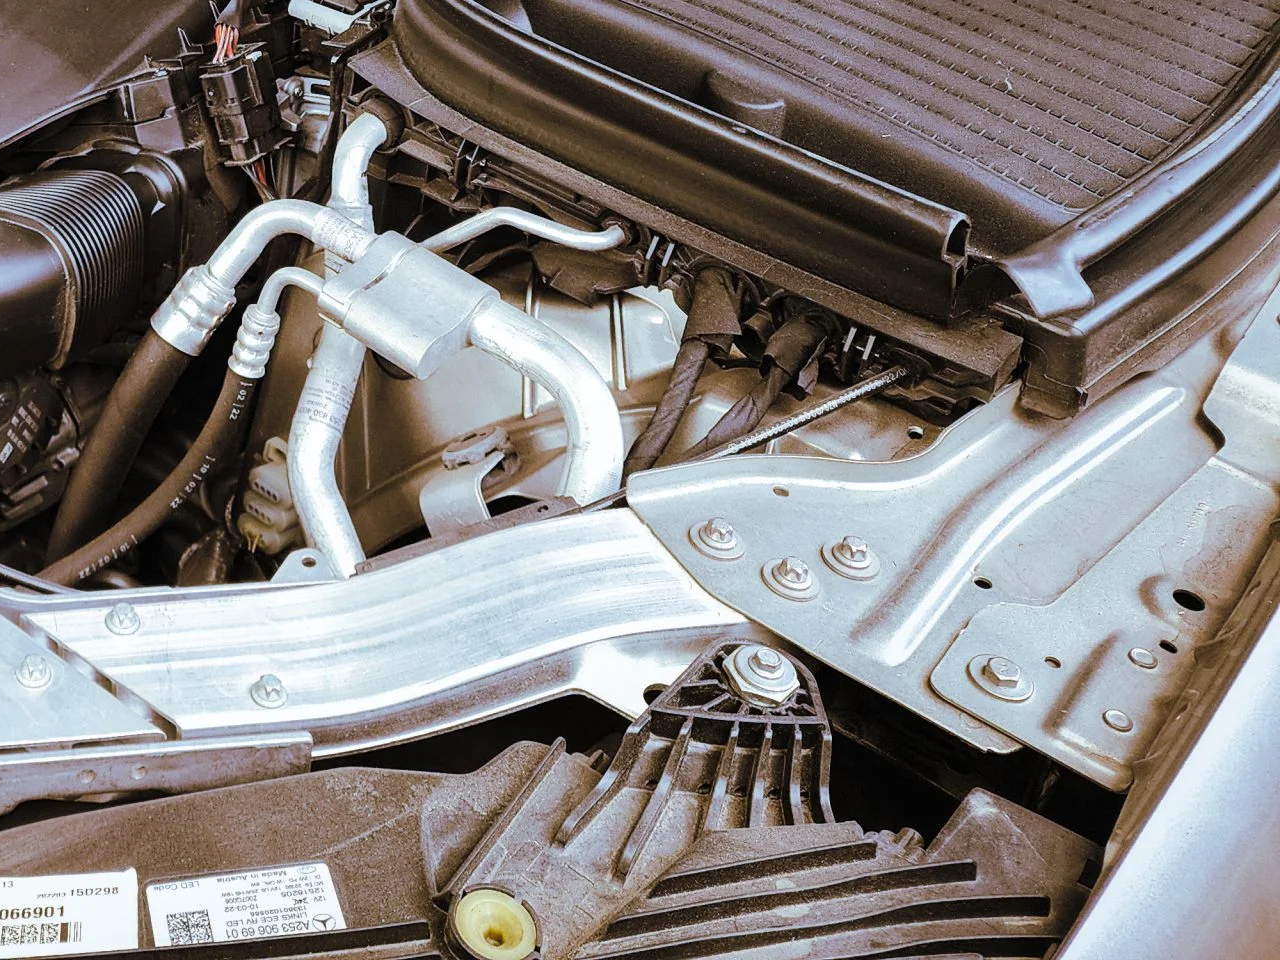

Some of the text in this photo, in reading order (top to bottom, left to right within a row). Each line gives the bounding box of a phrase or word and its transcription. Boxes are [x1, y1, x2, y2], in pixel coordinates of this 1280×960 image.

[216, 874, 248, 883] Austria
[260, 870, 287, 878] Made
[153, 880, 200, 891] LED Code
[224, 904, 259, 913] 10-03-22
[226, 912, 308, 928] LINKS ECE RV LED
[225, 920, 310, 939] A253 906 69 01
